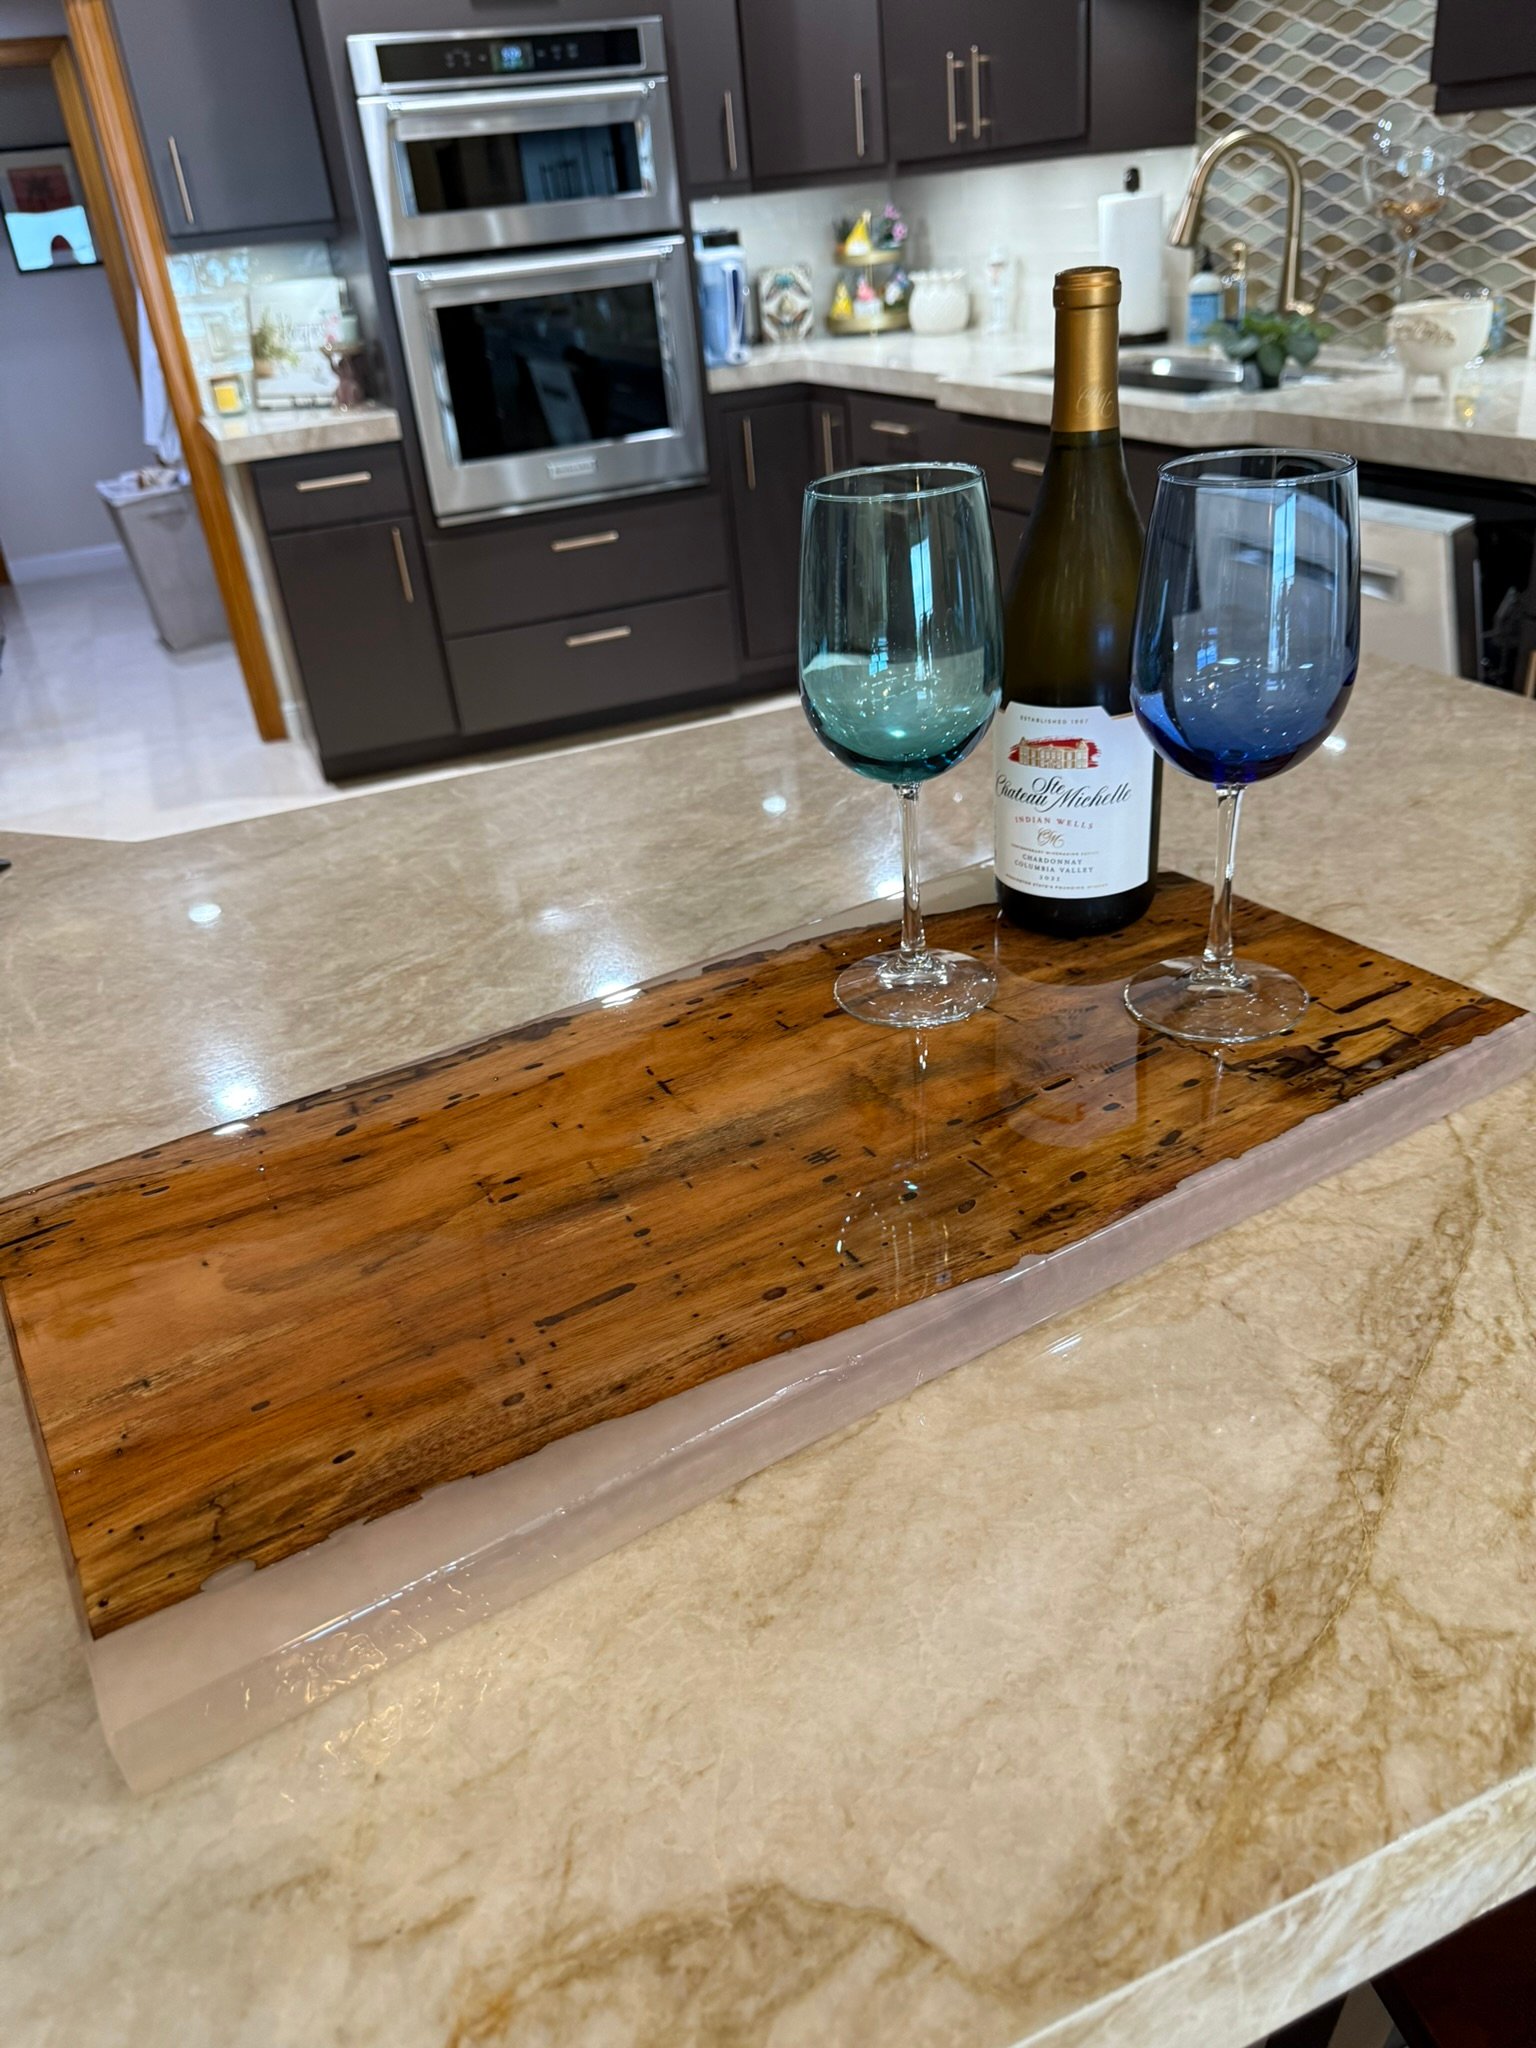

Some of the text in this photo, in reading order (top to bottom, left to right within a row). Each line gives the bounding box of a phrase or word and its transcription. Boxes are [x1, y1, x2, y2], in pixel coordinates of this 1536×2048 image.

[1020, 715, 1067, 725] ESTABLISHED
[995, 771, 1132, 814] Chateau Ste Michelle
[1015, 816, 1094, 829] INDIAN WELLS
[1014, 859, 1095, 874] COLUMBIA VALLEY
[1022, 854, 1083, 866] CHARDONNAY
